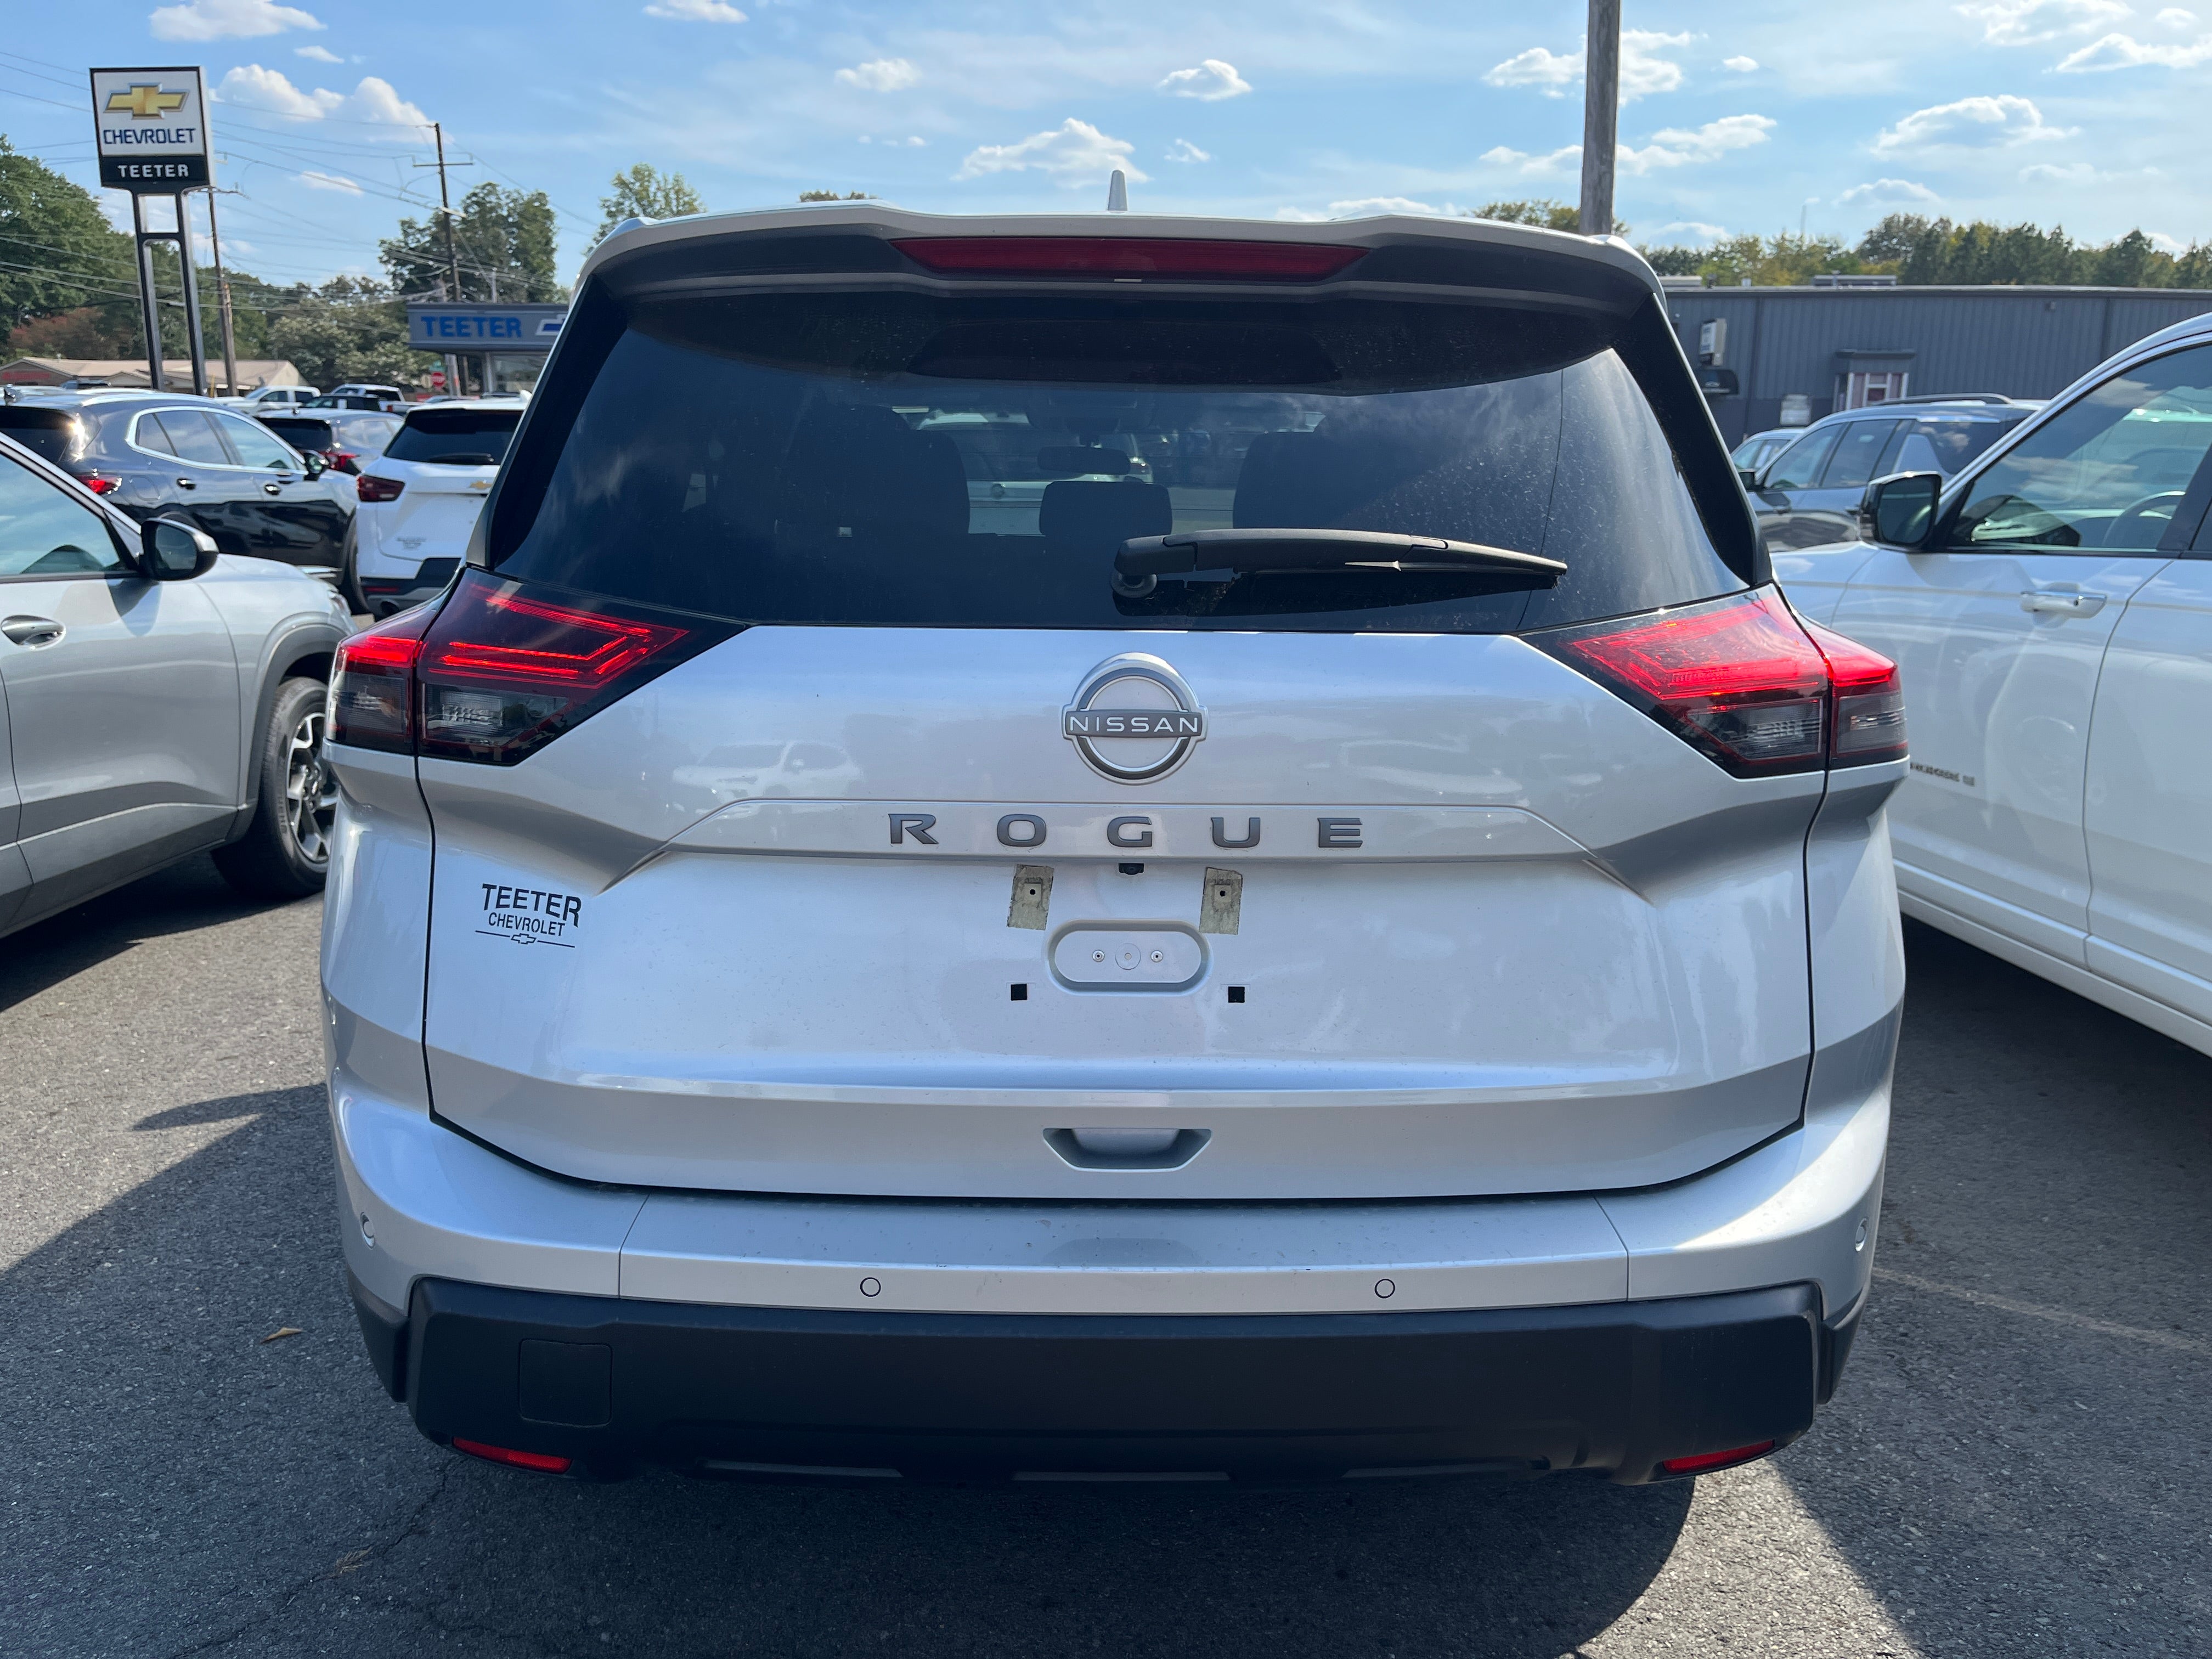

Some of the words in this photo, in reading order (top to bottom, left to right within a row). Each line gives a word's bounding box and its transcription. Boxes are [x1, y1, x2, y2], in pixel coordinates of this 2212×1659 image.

[103, 127, 196, 145] CHEVROLET
[117, 164, 189, 178] TEETER
[421, 316, 522, 338] TEETER
[1070, 715, 1199, 733] NISSAN
[888, 812, 1364, 849] ROGUE
[482, 883, 582, 928] TEETER
[488, 911, 566, 936] CHEVROLET
